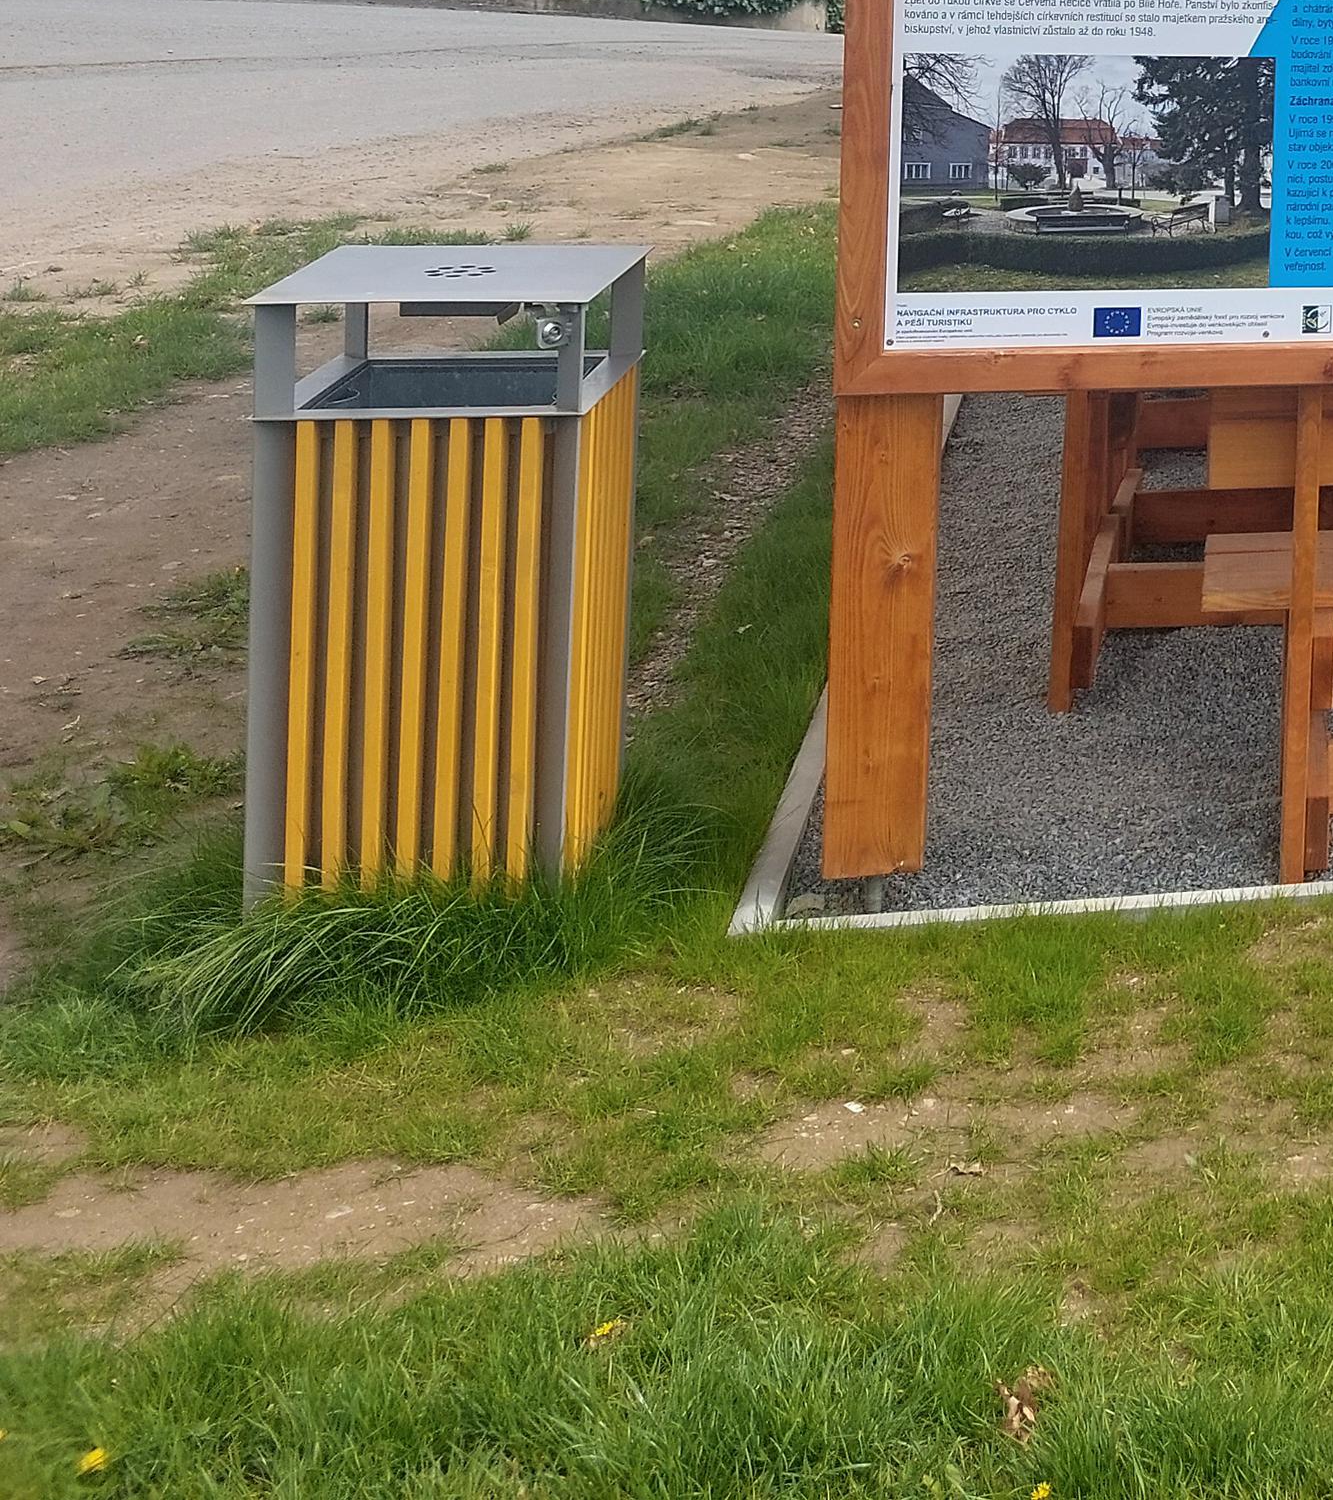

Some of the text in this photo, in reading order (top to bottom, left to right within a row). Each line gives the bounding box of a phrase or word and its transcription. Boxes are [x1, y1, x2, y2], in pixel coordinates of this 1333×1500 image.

[946, 308, 1025, 316] INFRASTRUKTURA
[1027, 307, 1047, 316] PRO
[1047, 307, 1077, 315] CYKLO
[896, 319, 903, 327] A
[926, 319, 973, 327] TURISTIKU
